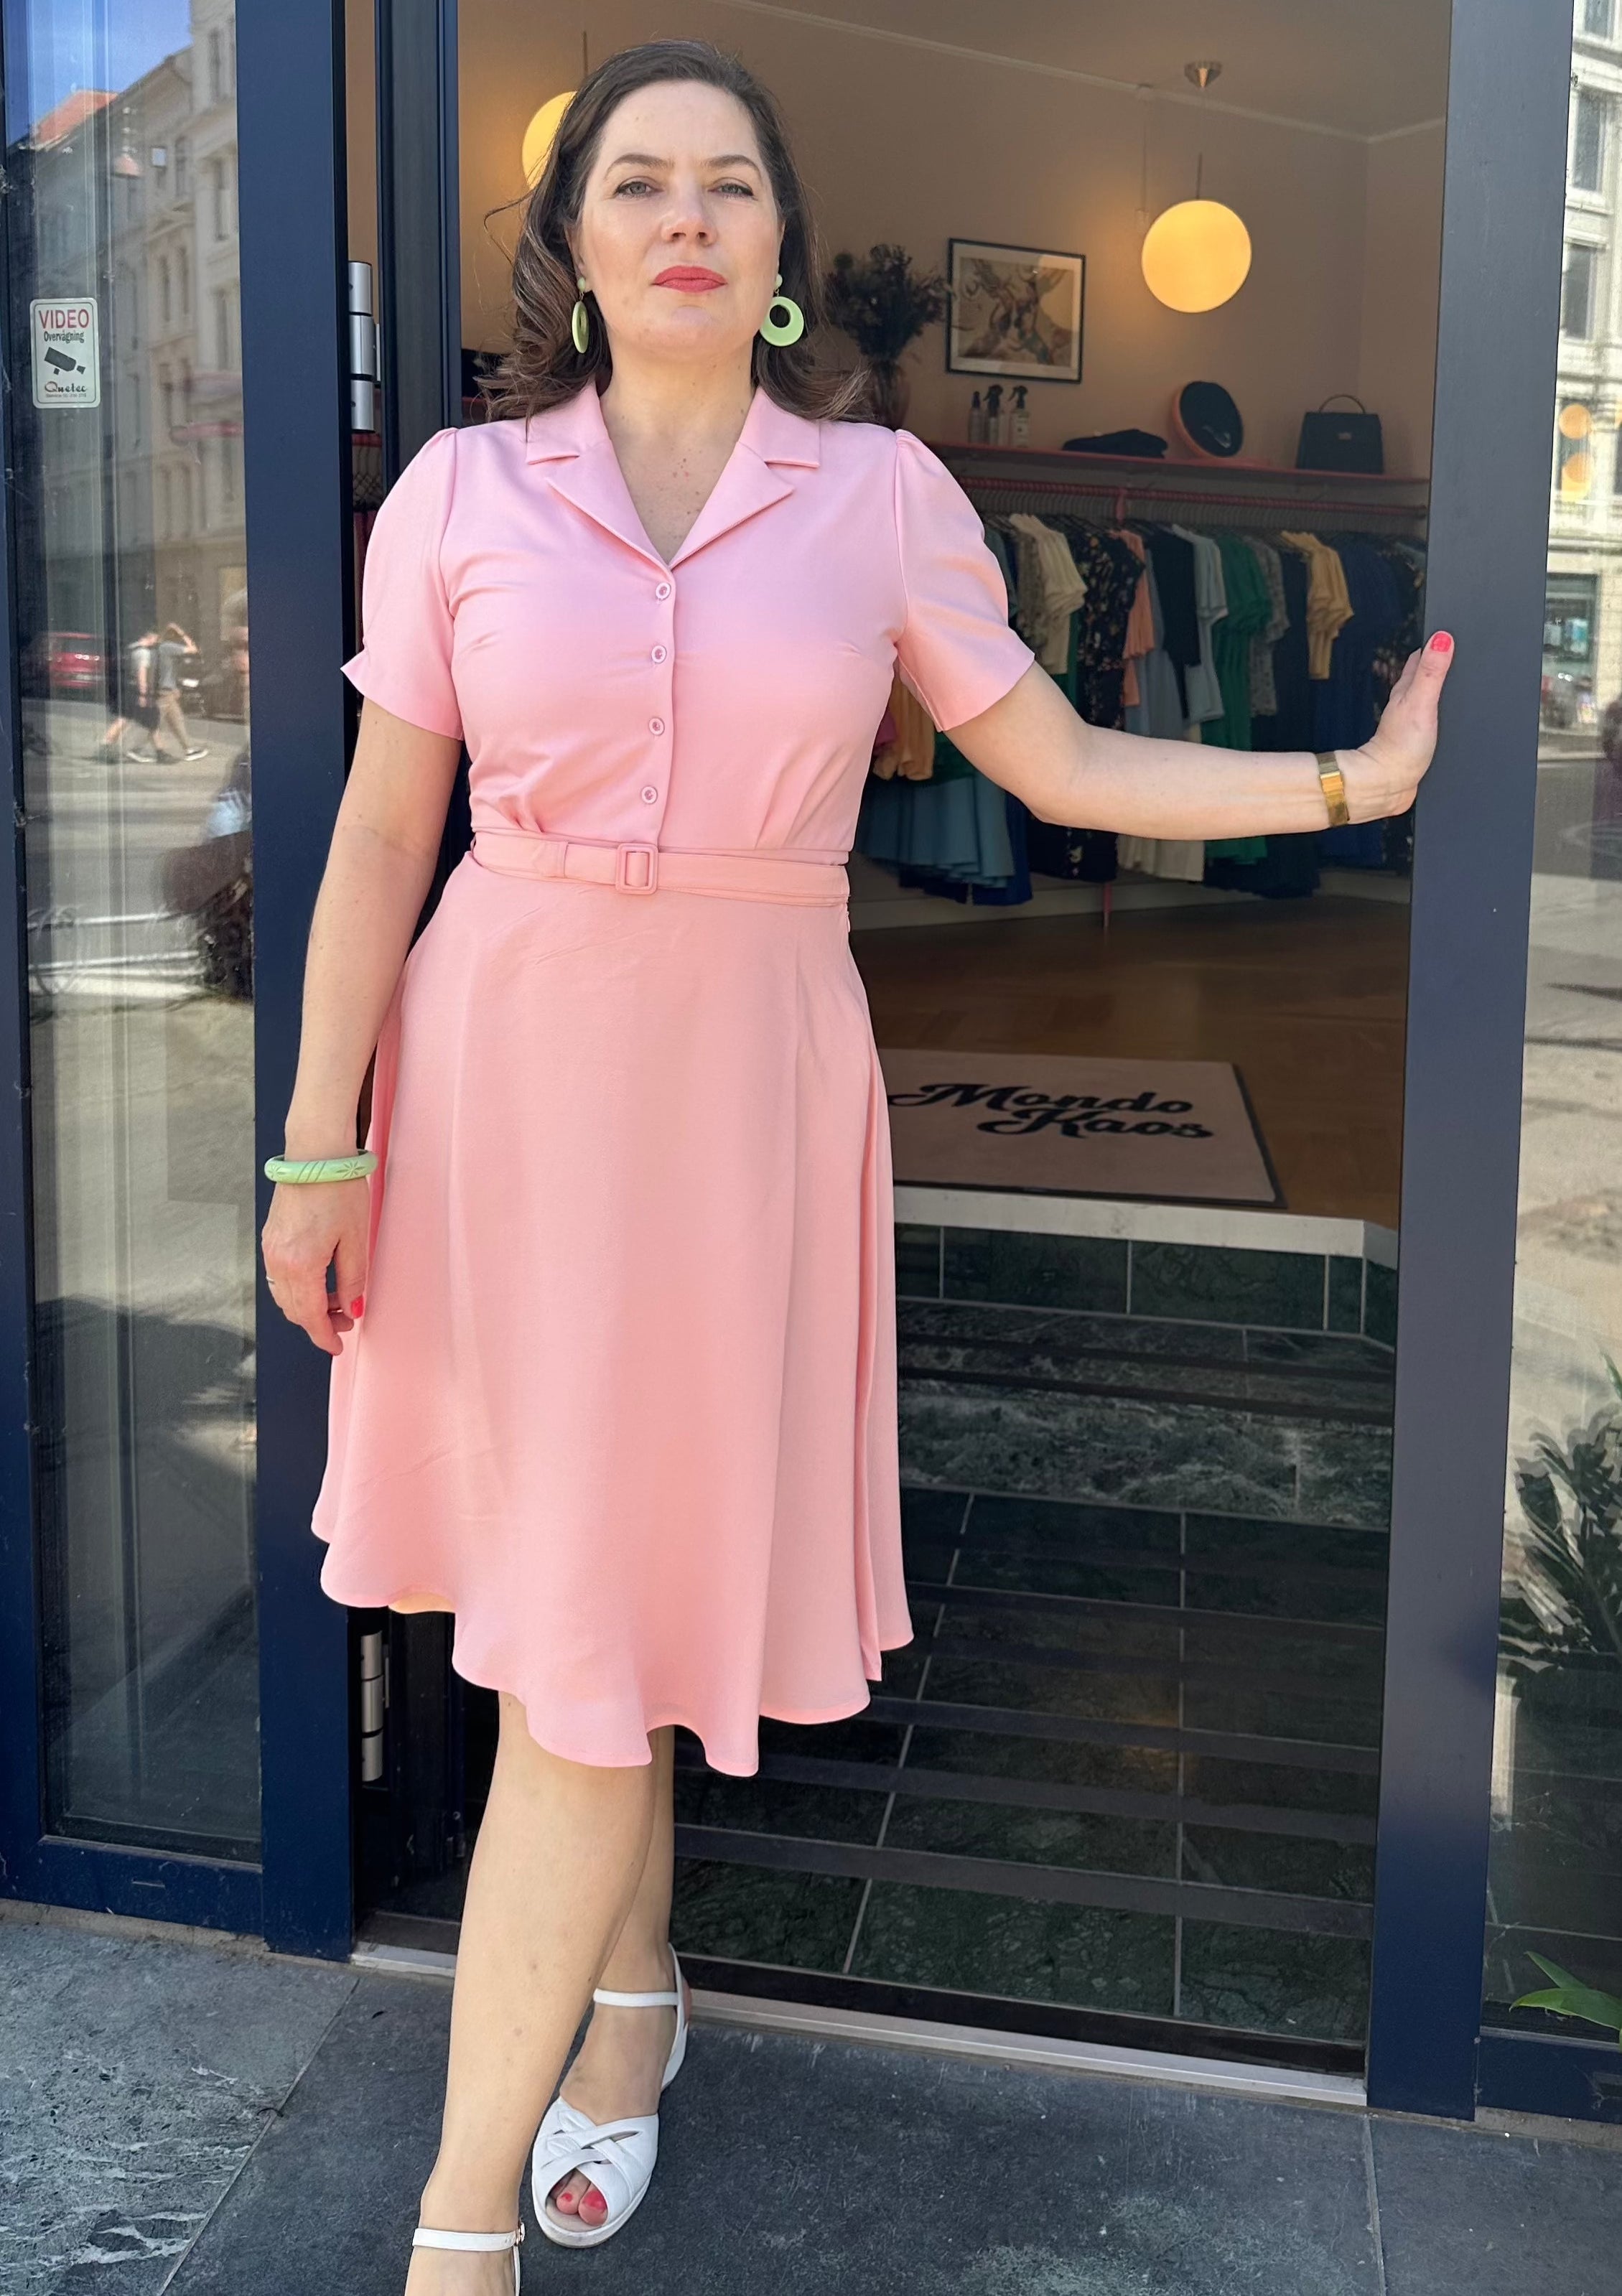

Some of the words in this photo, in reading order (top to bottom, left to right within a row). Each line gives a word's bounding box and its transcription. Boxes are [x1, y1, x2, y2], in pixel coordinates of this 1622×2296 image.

[39, 309, 89, 329] VIDEO
[44, 330, 84, 344] Overvågning
[888, 1083, 1193, 1114] Mondo
[977, 1108, 1214, 1139] Kaos
